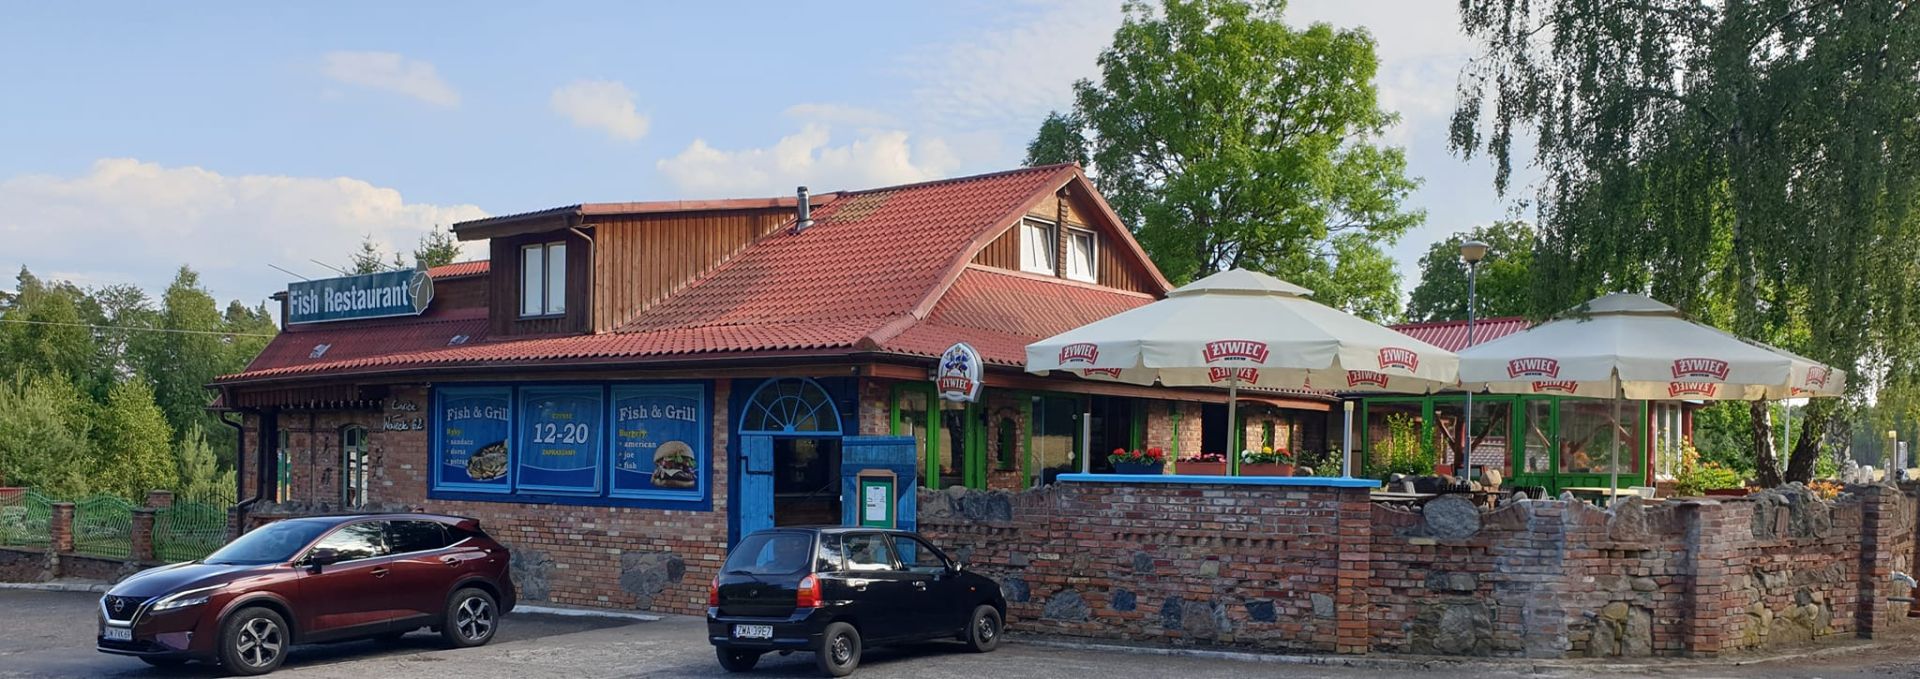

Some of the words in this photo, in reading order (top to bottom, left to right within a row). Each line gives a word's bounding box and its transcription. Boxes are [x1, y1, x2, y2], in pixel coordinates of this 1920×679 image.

[289, 288, 319, 316] Fish
[324, 280, 409, 313] Restaurant
[1064, 344, 1095, 358] ŻYWIEC
[1211, 341, 1262, 356] ŻYWIEC
[1382, 349, 1415, 365] ŻYWIEC
[1513, 359, 1554, 373] ŻYWIEC
[1680, 359, 1724, 374] ŻYWIEC
[447, 406, 471, 420] Fish
[473, 406, 482, 418] &
[619, 405, 648, 421] Fish
[651, 405, 662, 418] &
[665, 405, 696, 422] Grill
[533, 423, 589, 444] 12-20
[623, 450, 634, 460] joe
[623, 462, 637, 470] fish
